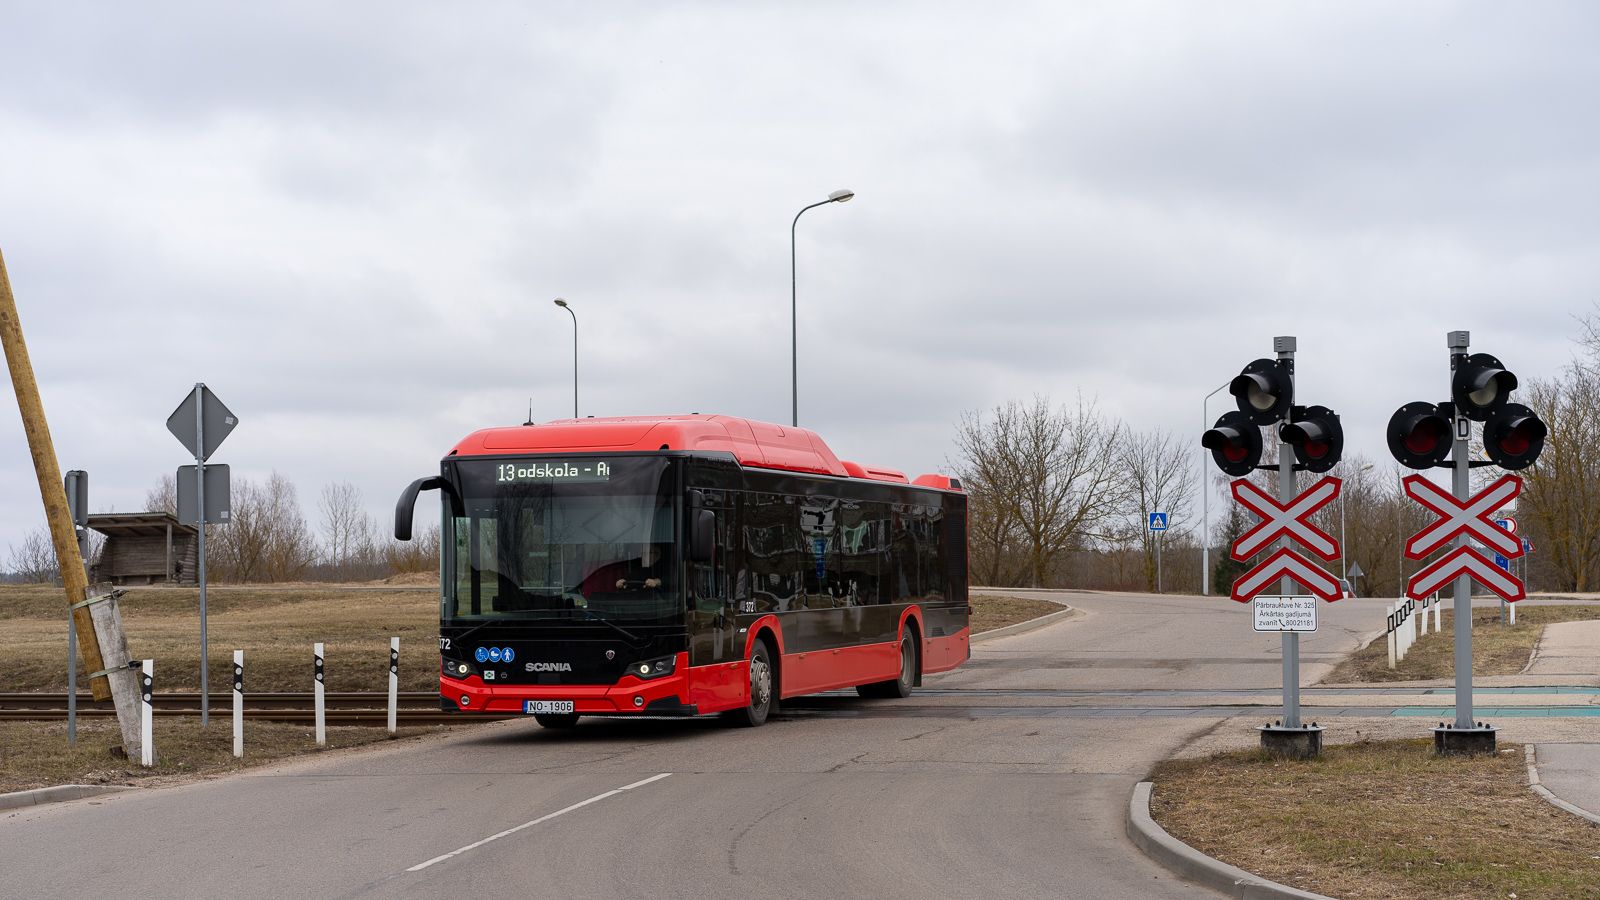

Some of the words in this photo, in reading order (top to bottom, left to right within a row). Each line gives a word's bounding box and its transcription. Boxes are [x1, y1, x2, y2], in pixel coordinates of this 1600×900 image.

[498, 464, 515, 481] 13
[517, 463, 578, 478] odskola
[745, 601, 754, 613] 372
[525, 662, 572, 672] SCANIA
